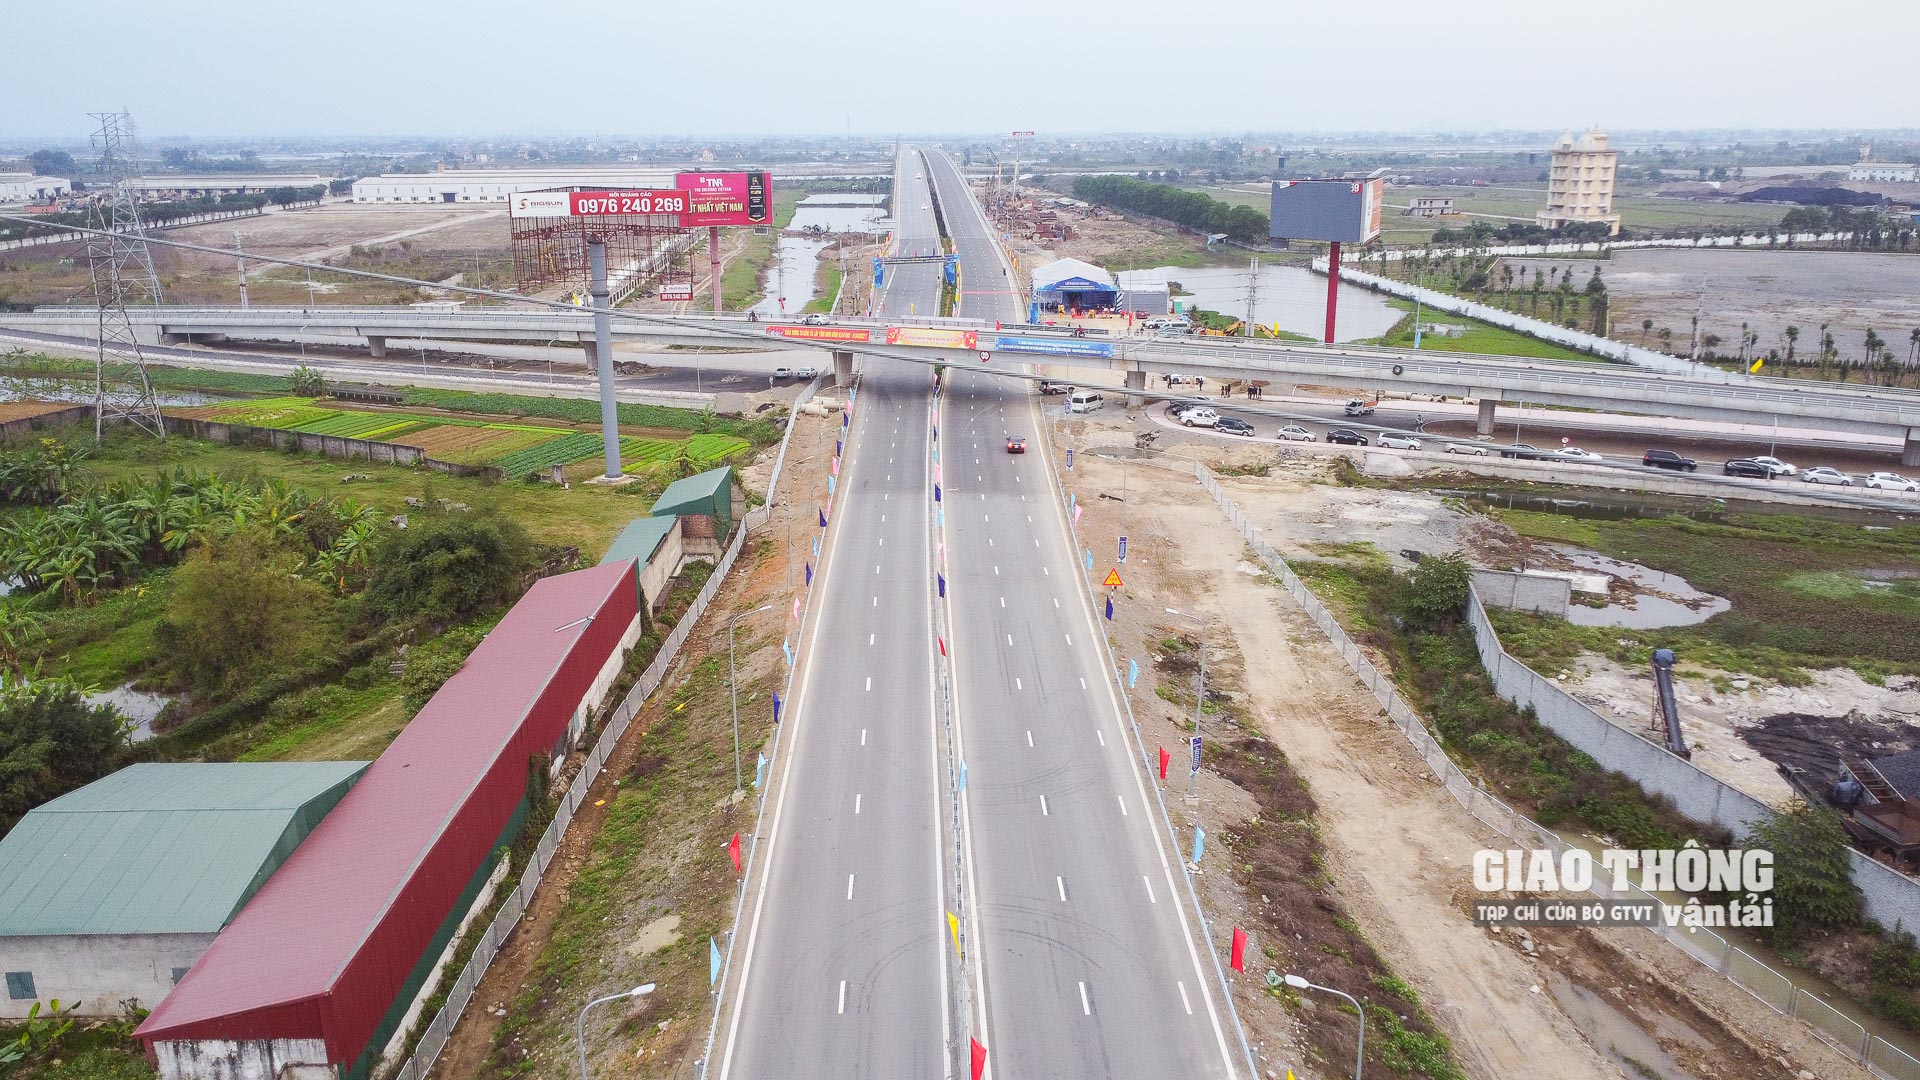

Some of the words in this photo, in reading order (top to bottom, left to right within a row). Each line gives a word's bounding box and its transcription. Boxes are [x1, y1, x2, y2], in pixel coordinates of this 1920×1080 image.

[706, 178, 723, 187] TNR
[578, 198, 618, 214] 0976
[621, 198, 651, 213] 240
[654, 197, 683, 212] 269
[697, 201, 714, 213] NHẤT
[714, 201, 728, 213] VIỆT
[729, 202, 744, 212] NAM
